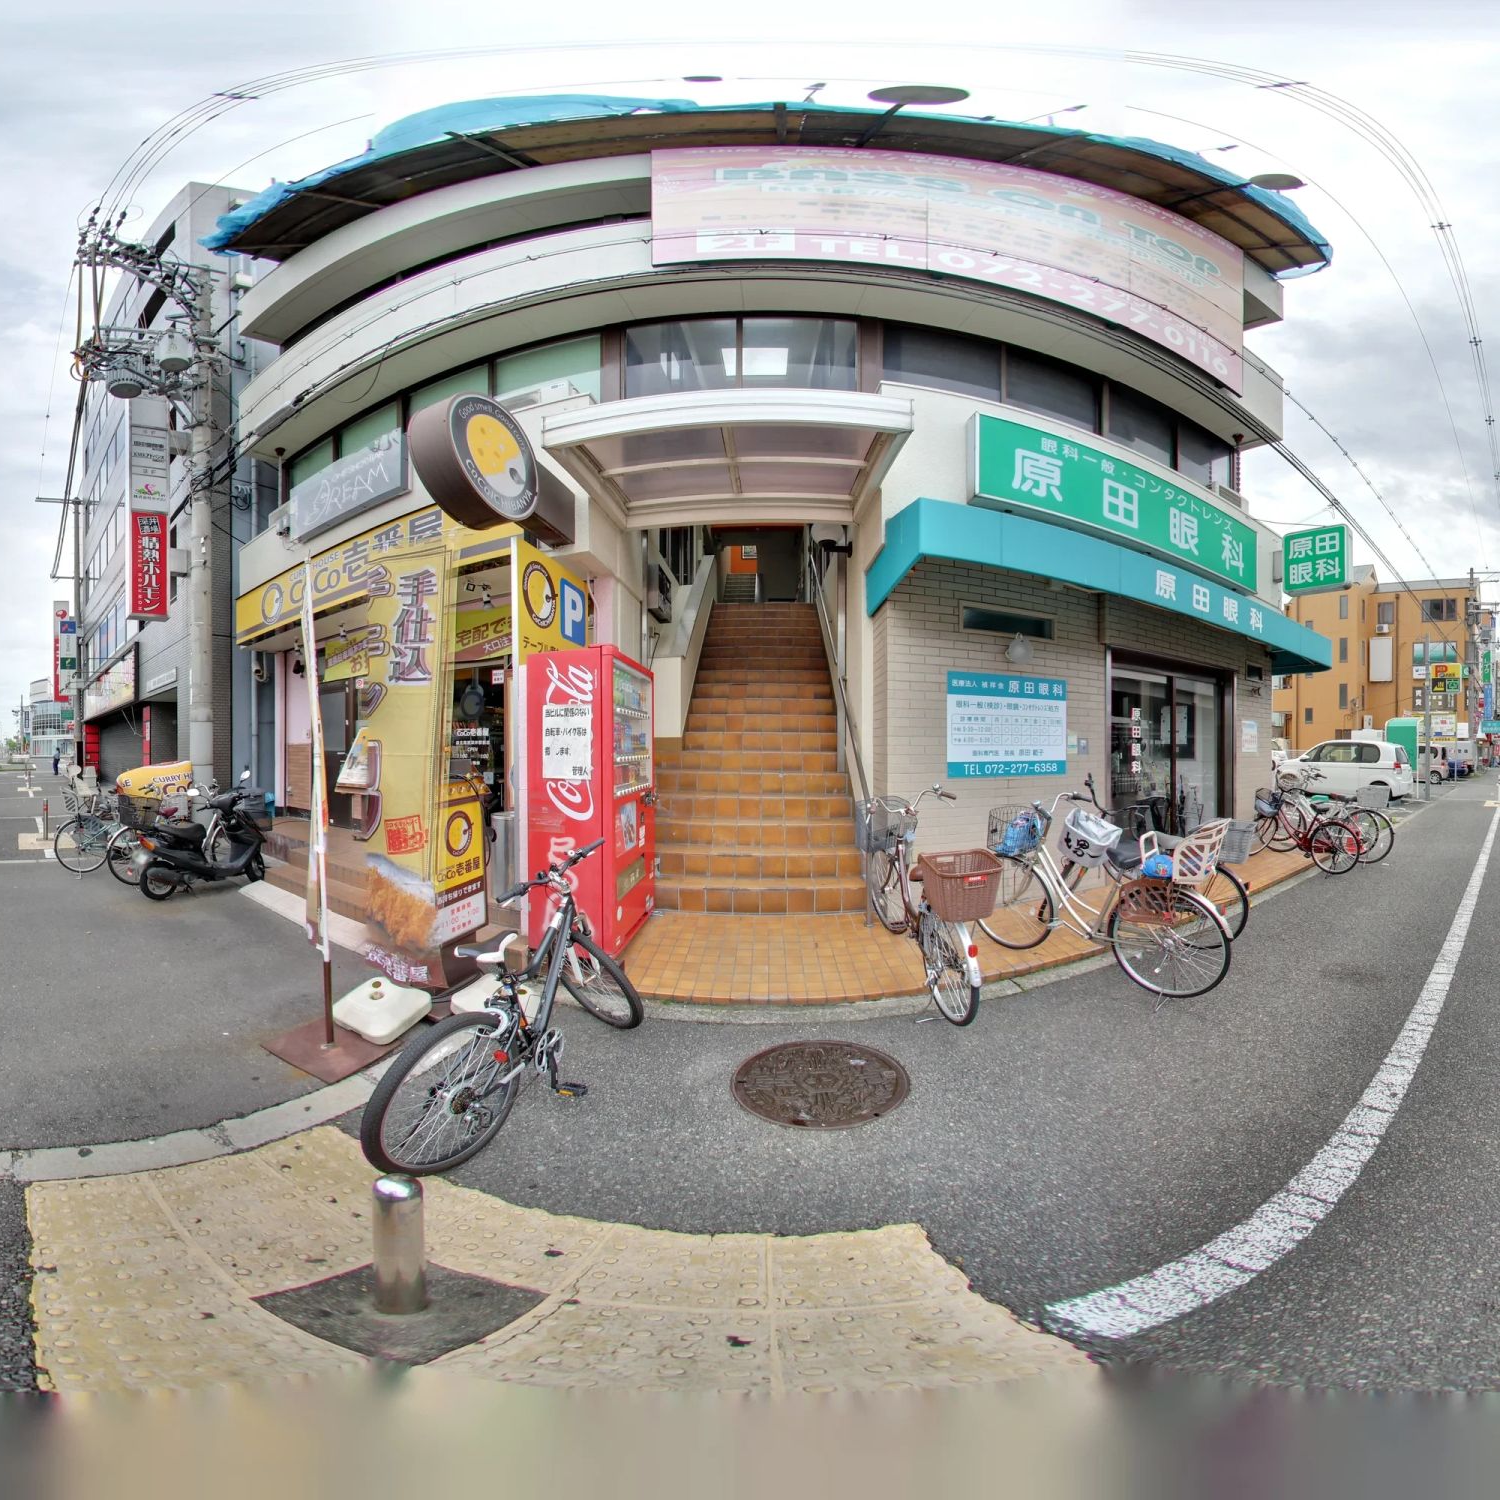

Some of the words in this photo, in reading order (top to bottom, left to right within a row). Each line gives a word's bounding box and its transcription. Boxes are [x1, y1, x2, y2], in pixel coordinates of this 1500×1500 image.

[714, 167, 970, 192] BASS
[1041, 437, 1234, 533] 眼科一般・コンタクトレンズ
[1012, 448, 1244, 577] 原田眼科
[1289, 532, 1340, 560] 原田
[142, 536, 160, 611] 情熱ホルモン
[313, 551, 340, 570] HOUSE
[1289, 557, 1341, 585] 眼科
[564, 584, 584, 637] P
[1155, 569, 1263, 634] 原田眼科
[456, 616, 512, 647] 宅配で
[483, 634, 512, 653] 大口注
[1008, 680, 1063, 697] 原田眼科
[545, 728, 587, 738] 自転車・バイク等は
[1131, 707, 1141, 774] 原田眼科
[153, 774, 181, 783] CURRY
[963, 764, 981, 775] TEL
[985, 762, 1058, 774] 072-277-6358
